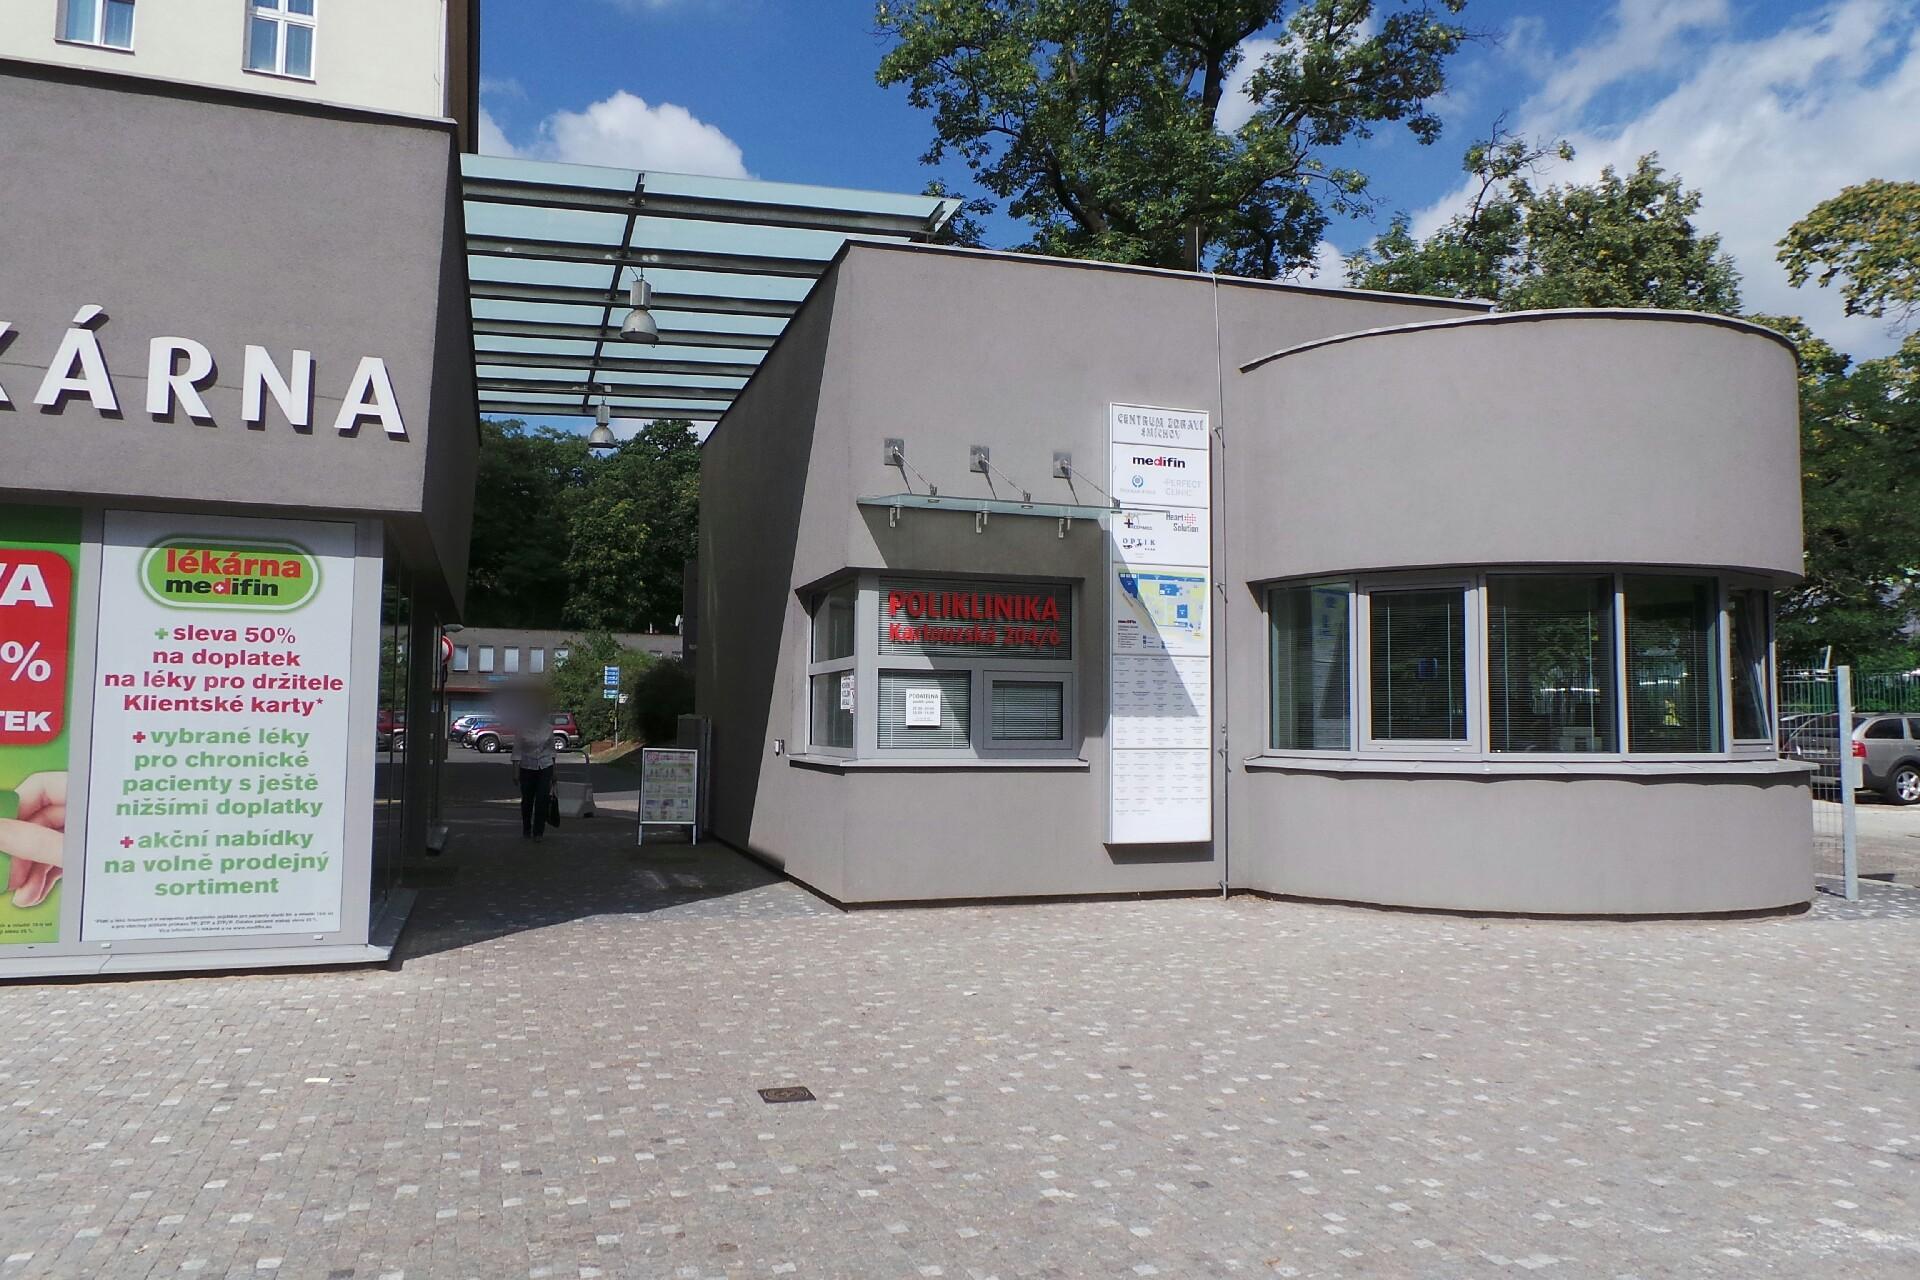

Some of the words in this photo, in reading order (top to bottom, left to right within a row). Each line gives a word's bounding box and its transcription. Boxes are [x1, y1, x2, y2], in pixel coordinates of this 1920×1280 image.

[1132, 456, 1186, 469] medifin
[1165, 510, 1184, 522] Heart
[1173, 522, 1199, 533] Solution
[166, 548, 302, 578] lékárna
[165, 577, 279, 597] medifin
[888, 589, 1060, 622] POLIKLINIKA
[173, 624, 237, 642] sleva
[244, 626, 297, 645] 50%
[888, 622, 997, 643] Kartouzská
[1003, 625, 1061, 649] 204/6
[152, 650, 184, 665] na
[191, 648, 302, 669] doplatek
[104, 673, 136, 687] na
[143, 670, 197, 692] léky
[204, 675, 246, 692] pro
[252, 673, 344, 691] držitele
[123, 694, 244, 713] Klientské
[150, 726, 252, 748] vybrané
[258, 727, 310, 748] léky
[134, 753, 178, 771] pro
[184, 750, 310, 768] chronické
[122, 775, 233, 796] pacienty
[238, 778, 252, 791] s
[256, 773, 319, 795] ještě
[115, 797, 209, 816] nižšími
[215, 798, 324, 819] doplatky
[137, 829, 210, 849] akční
[215, 828, 314, 850] nabídky
[104, 859, 136, 873] na
[142, 853, 214, 873] volně
[219, 850, 330, 875] prodejný
[154, 877, 280, 897] sortiment
